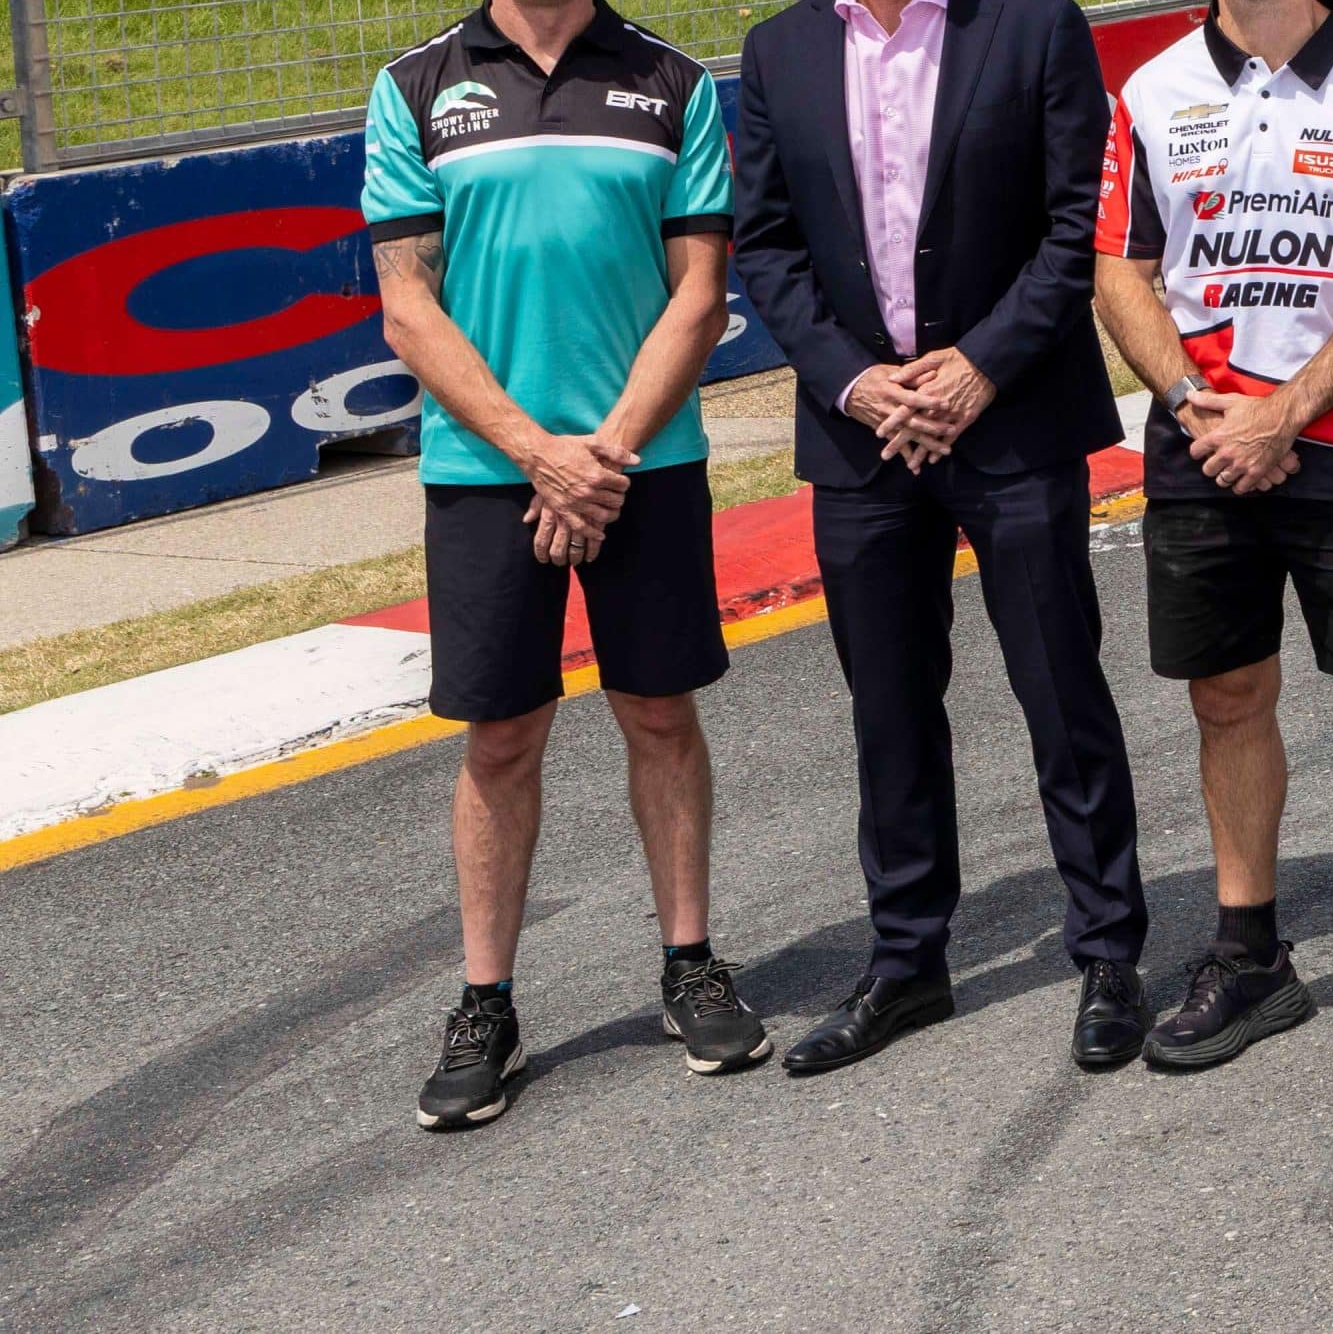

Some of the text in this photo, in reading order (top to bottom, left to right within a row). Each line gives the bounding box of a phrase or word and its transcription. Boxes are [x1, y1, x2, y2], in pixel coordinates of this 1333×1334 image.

[605, 89, 669, 117] BRT
[431, 108, 500, 132] SNOWY RIVER
[441, 119, 491, 139] RACING
[1168, 119, 1230, 135] CHEVROLET
[1180, 128, 1218, 138] RACING
[1167, 137, 1229, 157] Luxton
[1168, 155, 1201, 167] HOMES
[1171, 160, 1229, 184] HIFLEX
[1202, 280, 1320, 309] RACING
